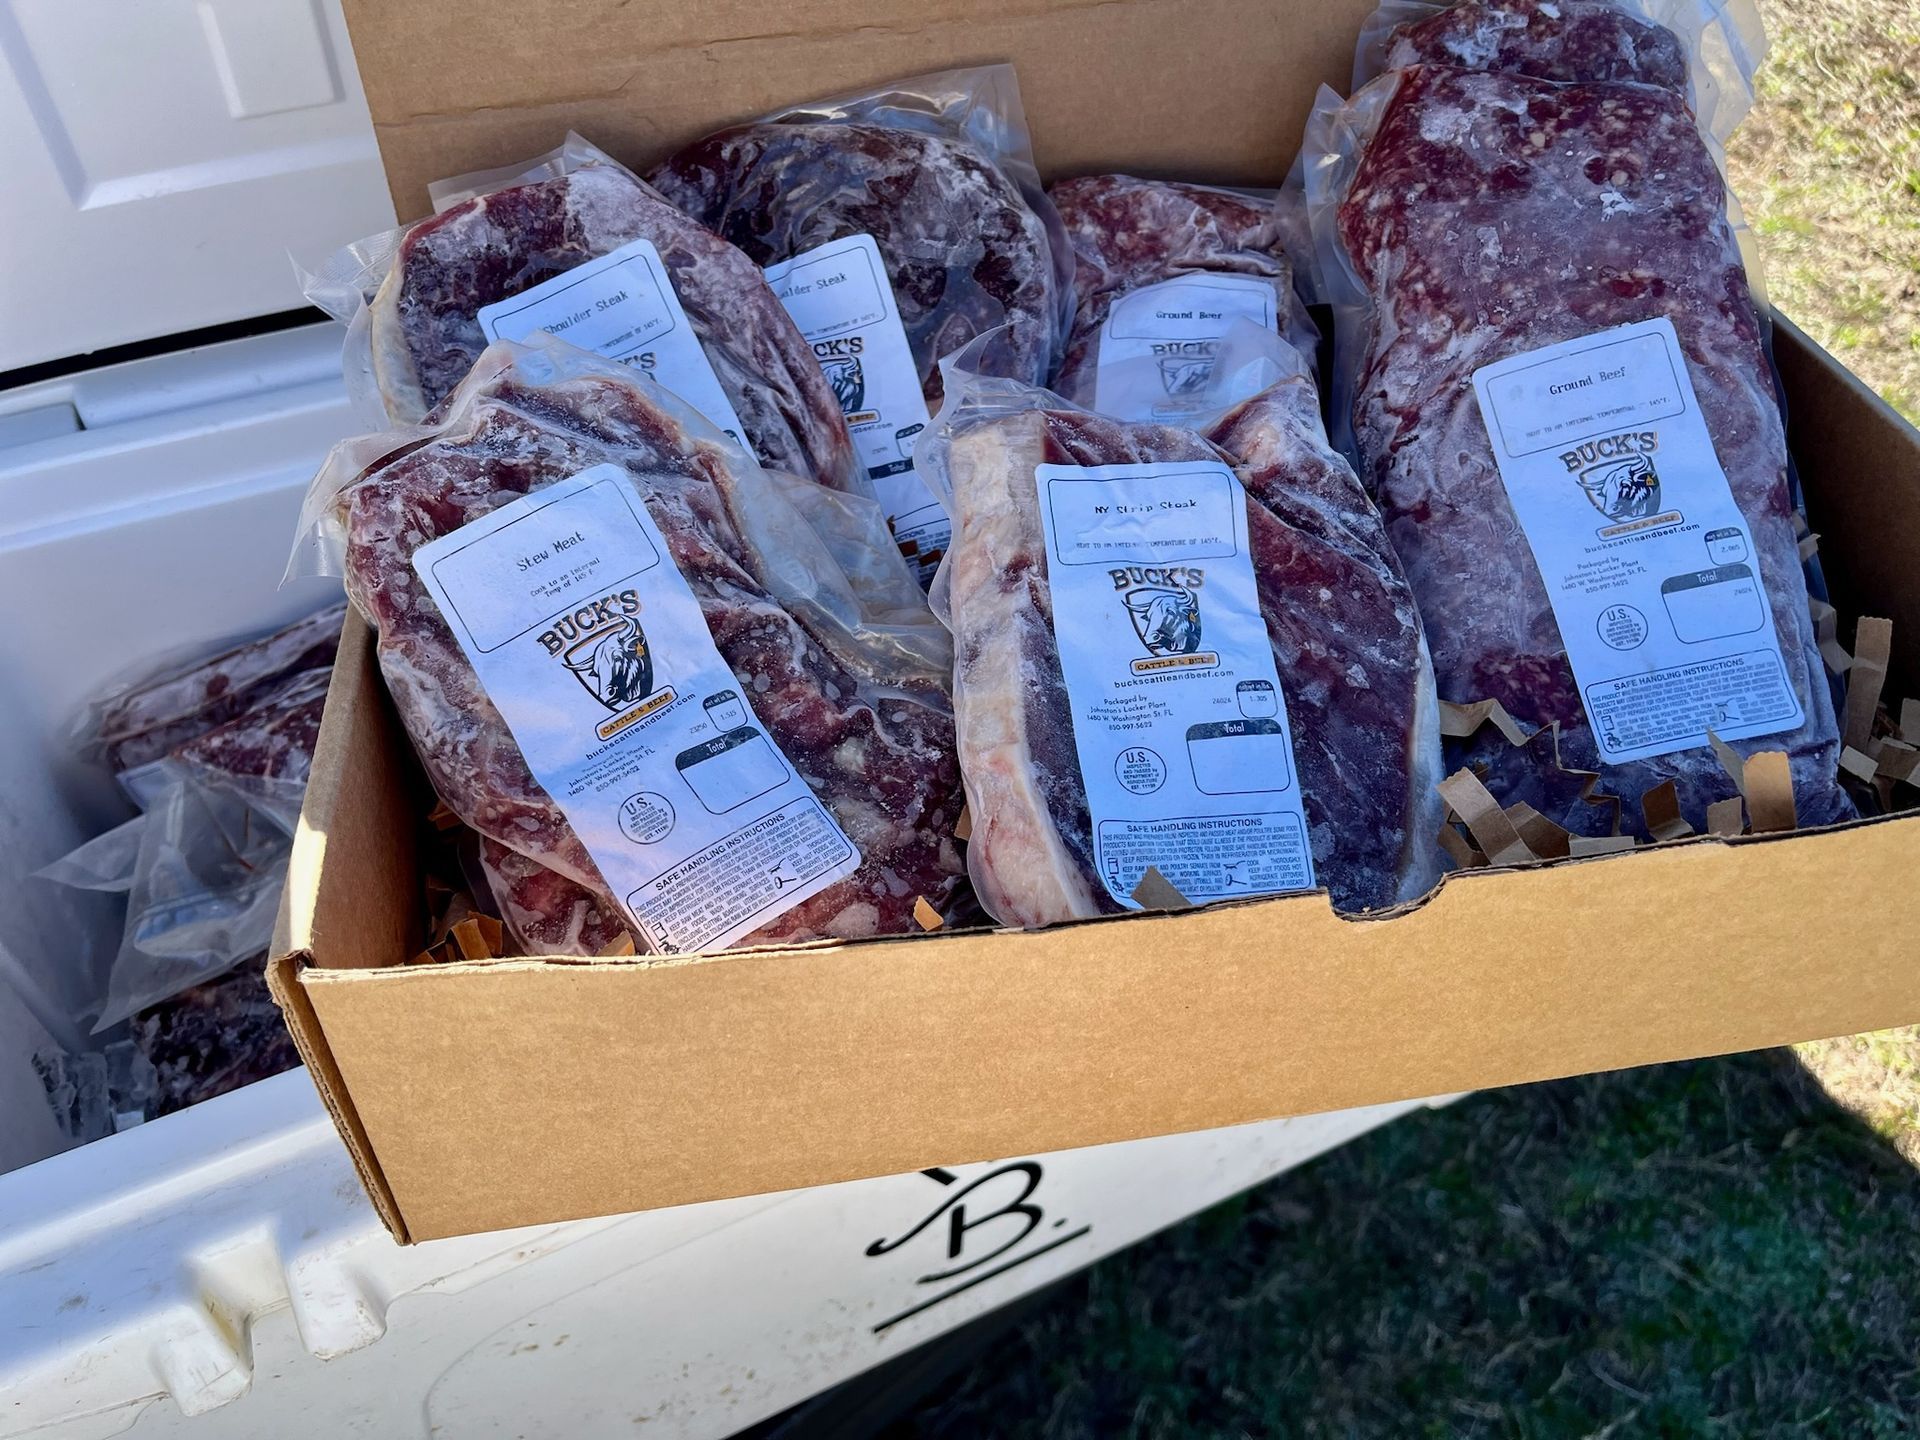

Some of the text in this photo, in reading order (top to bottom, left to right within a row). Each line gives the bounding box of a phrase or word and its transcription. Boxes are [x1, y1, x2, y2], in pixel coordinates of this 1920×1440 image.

[780, 273, 847, 299] ulder Steak
[541, 308, 593, 336] Shoulder
[595, 290, 628, 311] Steak
[1156, 311, 1193, 320] Ground
[813, 337, 863, 357] CK'S
[1151, 341, 1214, 355] BUCK
[1549, 366, 1625, 395] Ground Beef
[1558, 431, 1659, 474] BUCK'S
[1095, 499, 1196, 513] NY Strip Steak
[1584, 523, 1699, 553] buckscattleandbeef.com
[516, 531, 584, 571] Stew Meat
[529, 556, 600, 597] Cook to an Internal
[1107, 567, 1205, 593] BUCK'S
[1696, 570, 1717, 583] Total
[544, 585, 561, 597] Temp
[562, 579, 571, 588] of
[536, 588, 642, 657] BUCK'S
[1606, 607, 1630, 621] U.S.
[1137, 659, 1175, 670] CATTLE
[1613, 657, 1744, 690] SAFE HANDLING INSTRUCTIONS
[1114, 670, 1233, 688] buckscattleandbeef.com
[1103, 696, 1137, 705] Packaged
[1123, 703, 1146, 712] Locker
[602, 710, 637, 733] CATTLE
[646, 692, 668, 708] BEEF
[1111, 713, 1151, 722] Washington
[585, 692, 696, 761] buckscattleandbeef.com
[1223, 723, 1245, 733] Total
[705, 737, 726, 753] Total
[1125, 751, 1149, 763] U.S.
[567, 784, 585, 796] 1480
[584, 778, 593, 786] W.
[594, 759, 634, 781] Washington
[644, 747, 655, 755] FL
[624, 796, 651, 815] U.S.
[1127, 818, 1262, 832] SAFE HANDLING INSTRUCTIONS
[655, 871, 680, 890] SAFE
[680, 845, 726, 875] HANDLING
[725, 813, 785, 848] INSTRUCTIONS
[786, 850, 800, 861] COOK
[790, 857, 802, 867] KEEP
[802, 851, 812, 860] HOT
[663, 911, 677, 923] KEEP
[676, 889, 714, 915] REFRIGERATED
[712, 884, 722, 893] OR
[668, 921, 680, 931] KEEP
[680, 914, 692, 924] RAW
[690, 906, 704, 917] MEAT
[703, 900, 714, 910] AND
[752, 869, 766, 880] FROM
